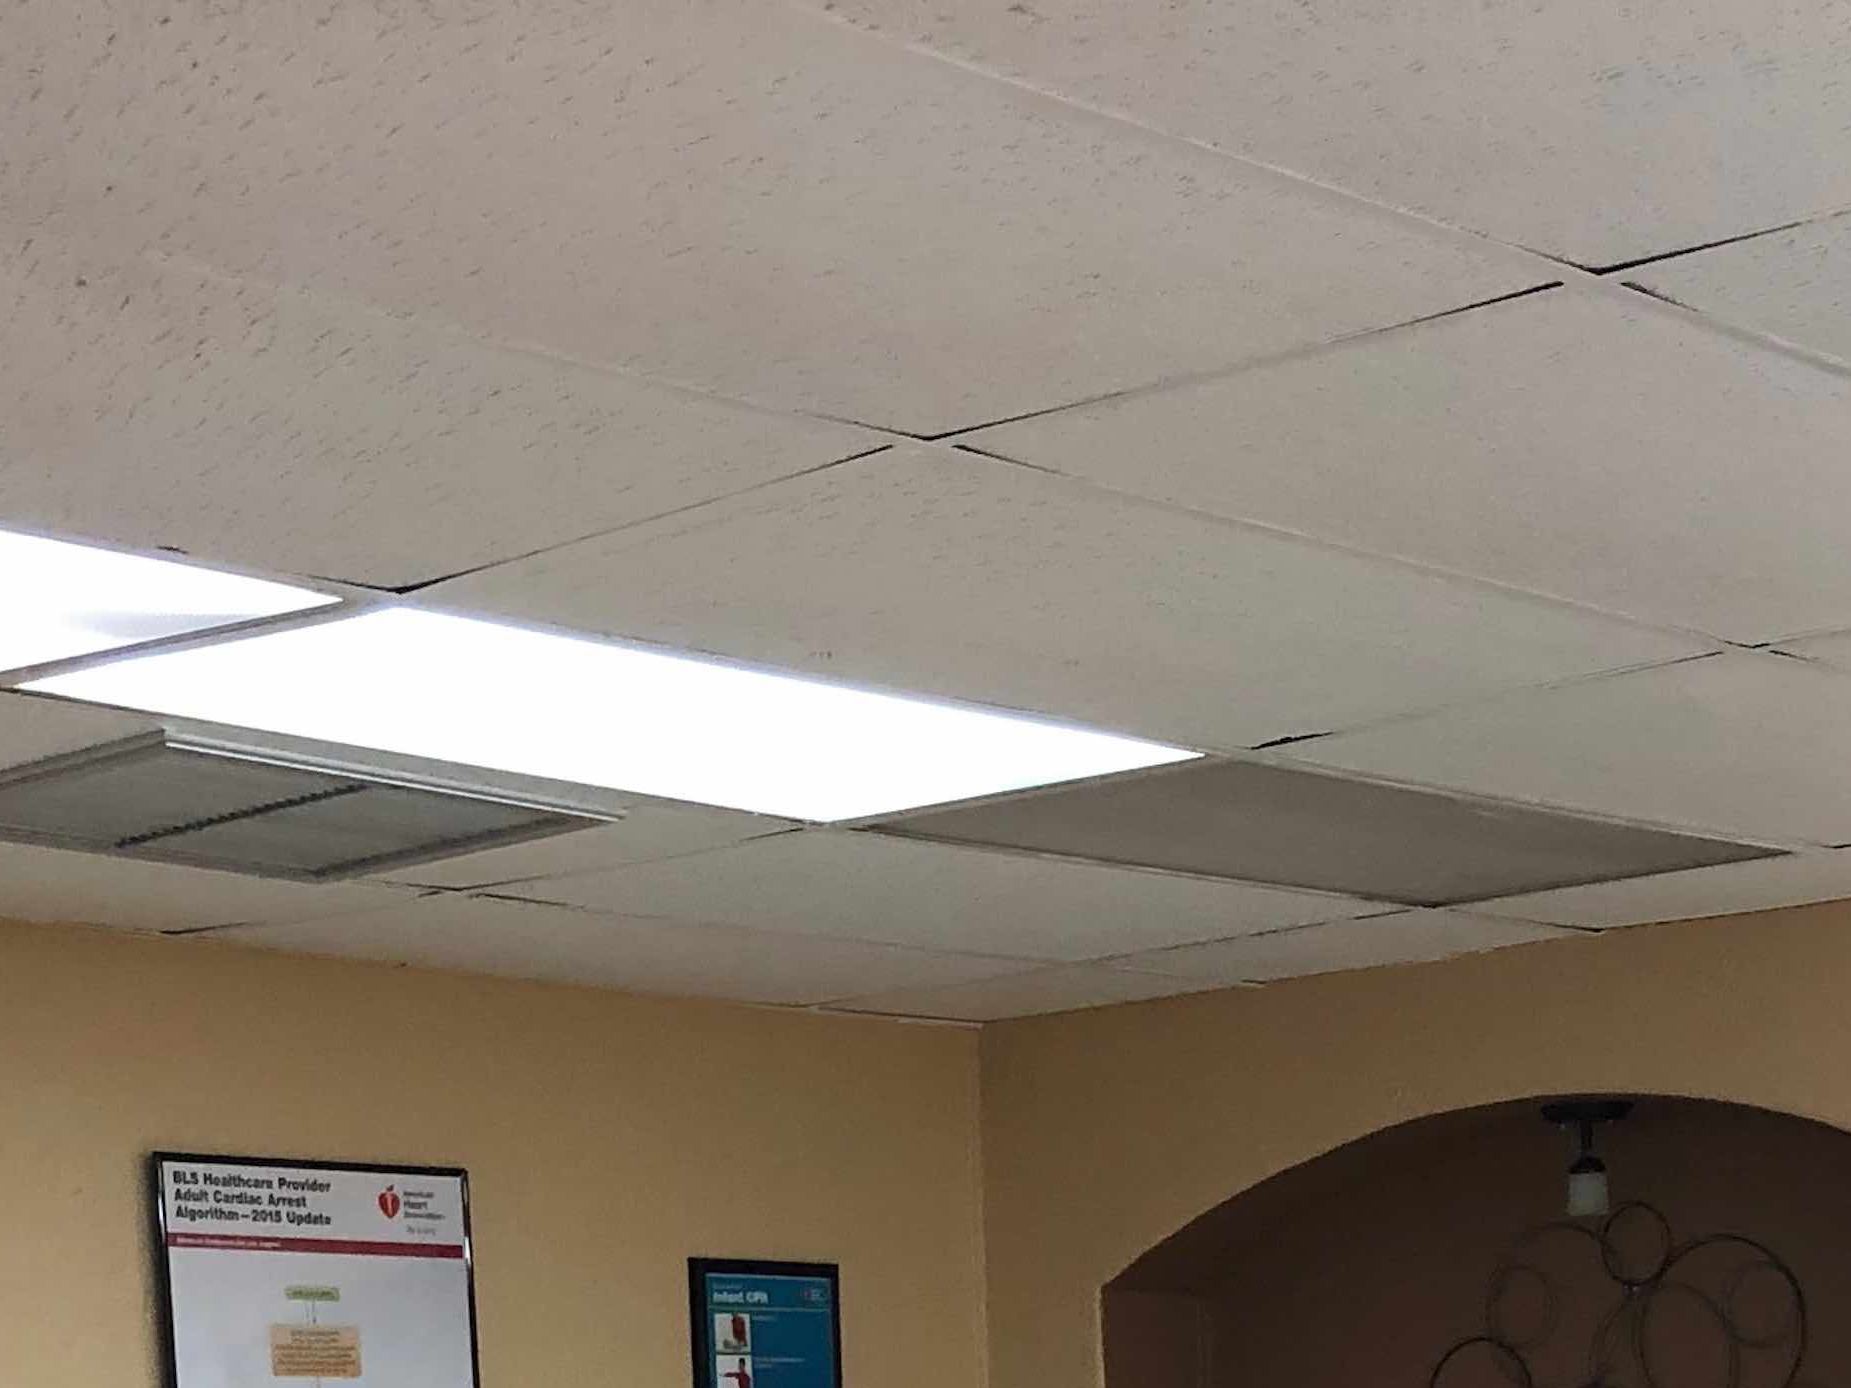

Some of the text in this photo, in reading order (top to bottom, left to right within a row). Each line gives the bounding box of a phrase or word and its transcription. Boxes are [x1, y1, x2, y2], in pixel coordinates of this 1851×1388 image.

[172, 1170, 332, 1193] BLS Healthcare Provider
[174, 1188, 307, 1208] Adult Cardiac Arrest
[286, 1211, 332, 1226] Update
